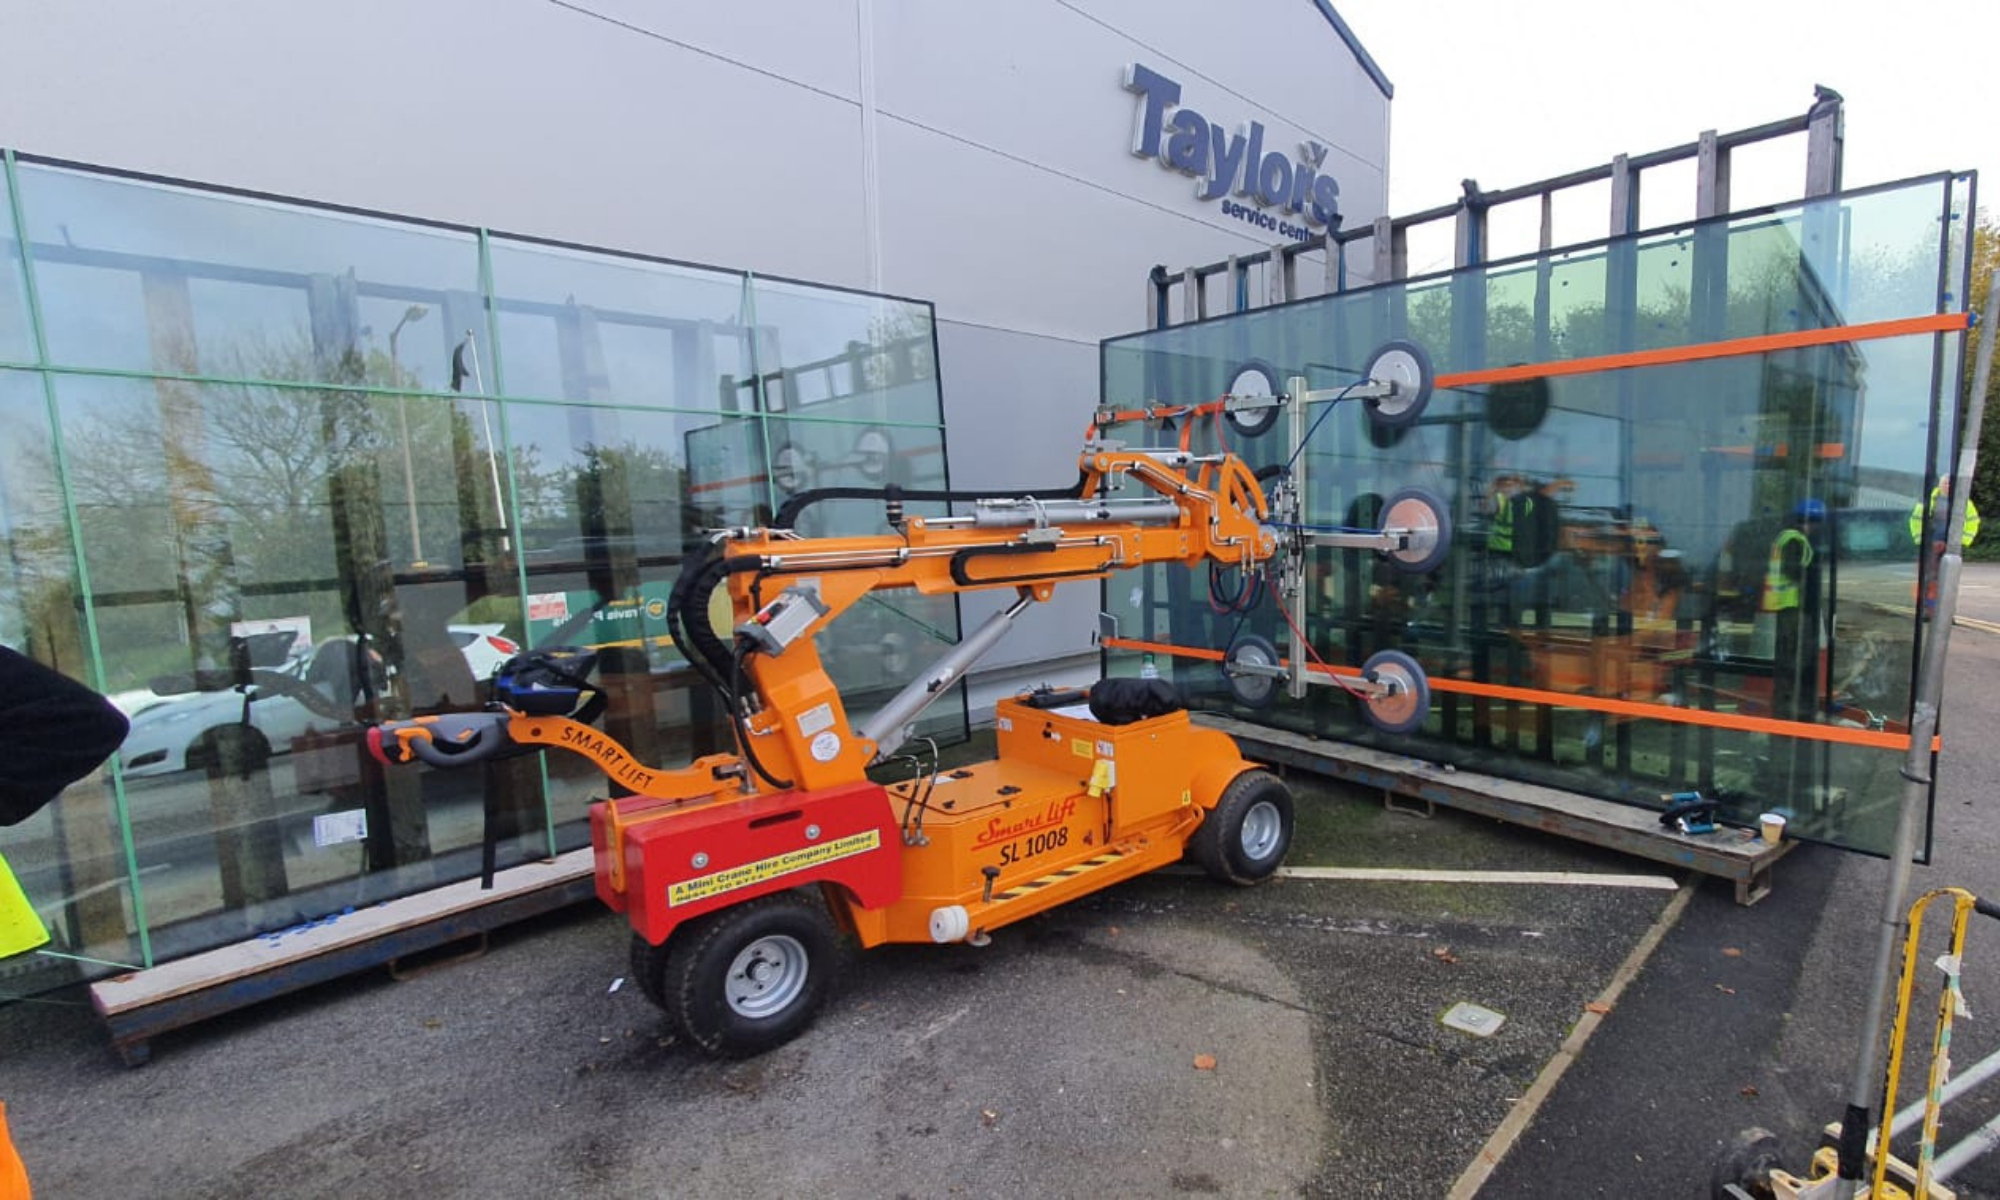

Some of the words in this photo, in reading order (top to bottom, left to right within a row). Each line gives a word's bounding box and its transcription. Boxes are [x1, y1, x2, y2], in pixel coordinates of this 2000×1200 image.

[1221, 199, 1277, 231] service
[561, 726, 623, 766] SMART
[618, 763, 655, 789] LIFT
[976, 814, 1042, 844] Smart
[1000, 843, 1020, 867] SL
[1025, 826, 1068, 858] 1008
[675, 885, 685, 895] A
[688, 878, 714, 892] Mini
[716, 868, 752, 883] Crane
[755, 860, 779, 873] Hire
[782, 846, 833, 865] Company
[835, 834, 873, 850] Limited
